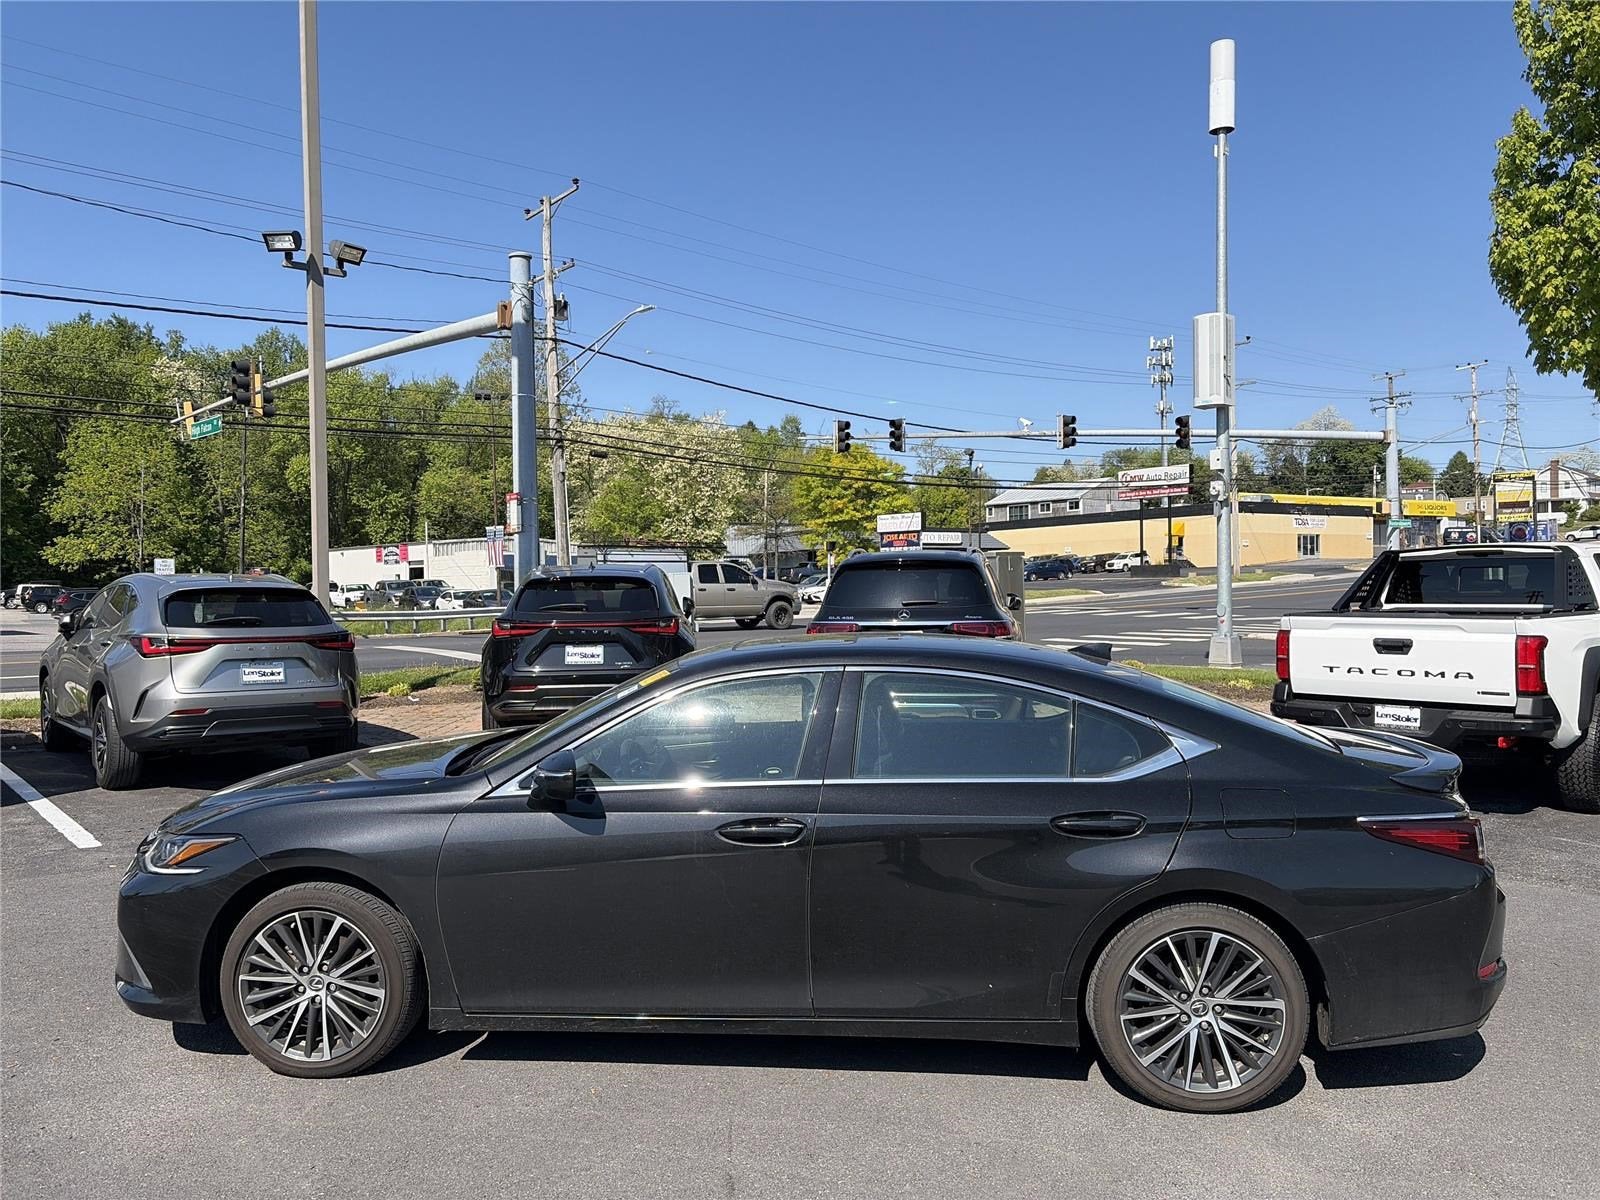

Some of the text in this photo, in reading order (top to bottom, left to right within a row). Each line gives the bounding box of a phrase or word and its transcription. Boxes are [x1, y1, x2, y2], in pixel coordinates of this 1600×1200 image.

[1146, 472, 1162, 481] Auto
[1164, 469, 1188, 482] Repair
[1322, 666, 1474, 680] TACOMA
[1376, 711, 1419, 723] Len Stoler
